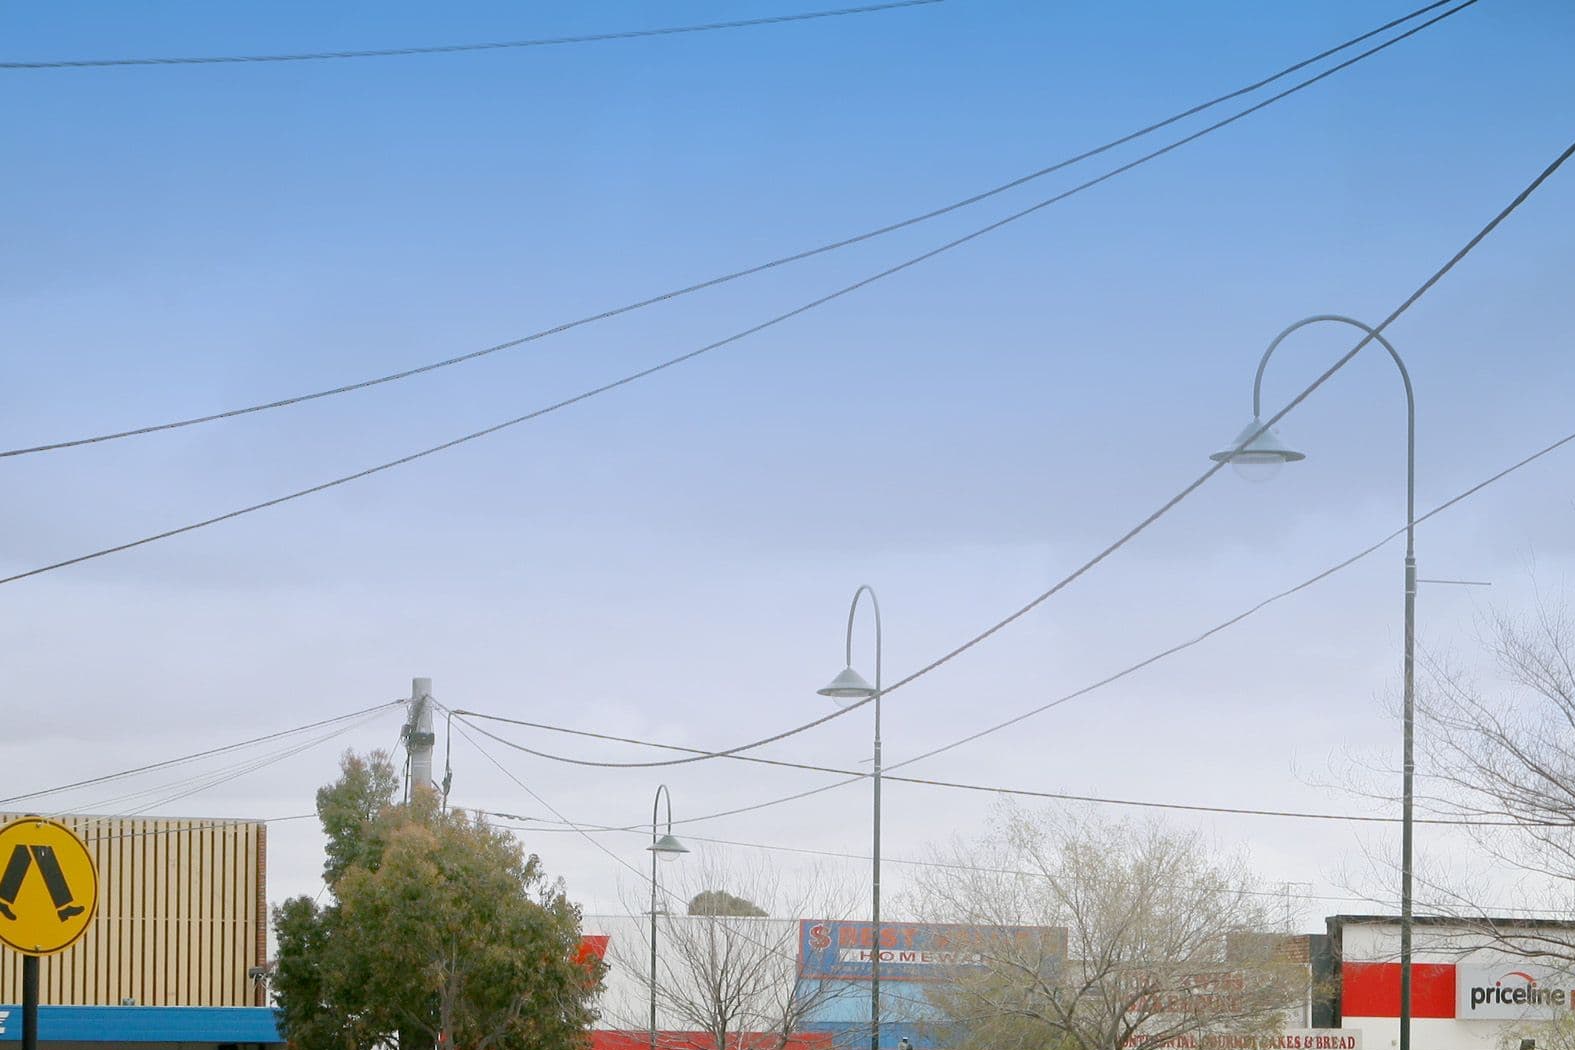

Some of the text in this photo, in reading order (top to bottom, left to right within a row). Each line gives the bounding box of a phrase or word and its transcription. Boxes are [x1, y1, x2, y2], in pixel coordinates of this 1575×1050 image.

[1471, 981, 1566, 1010] priceline
[1304, 1036, 1313, 1049] &
[1316, 1036, 1356, 1050] BREAD
